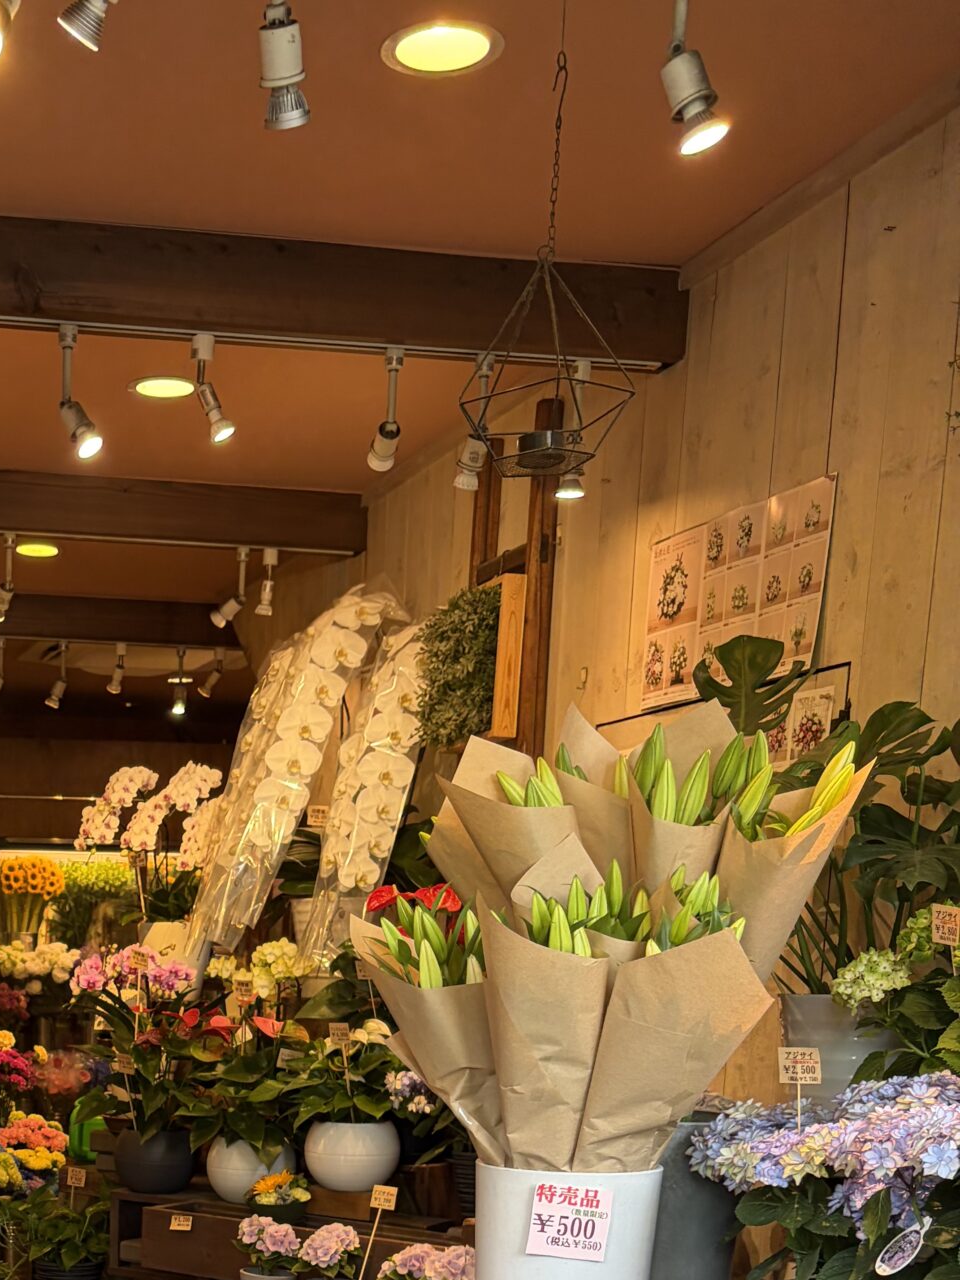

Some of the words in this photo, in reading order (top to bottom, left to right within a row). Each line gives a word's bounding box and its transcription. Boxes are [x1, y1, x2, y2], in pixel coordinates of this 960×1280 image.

[784, 1051, 814, 1060] アジサイ
[783, 1064, 816, 1075] ¥2,500
[536, 1183, 601, 1209] 特売品
[532, 1213, 596, 1240] ¥500
